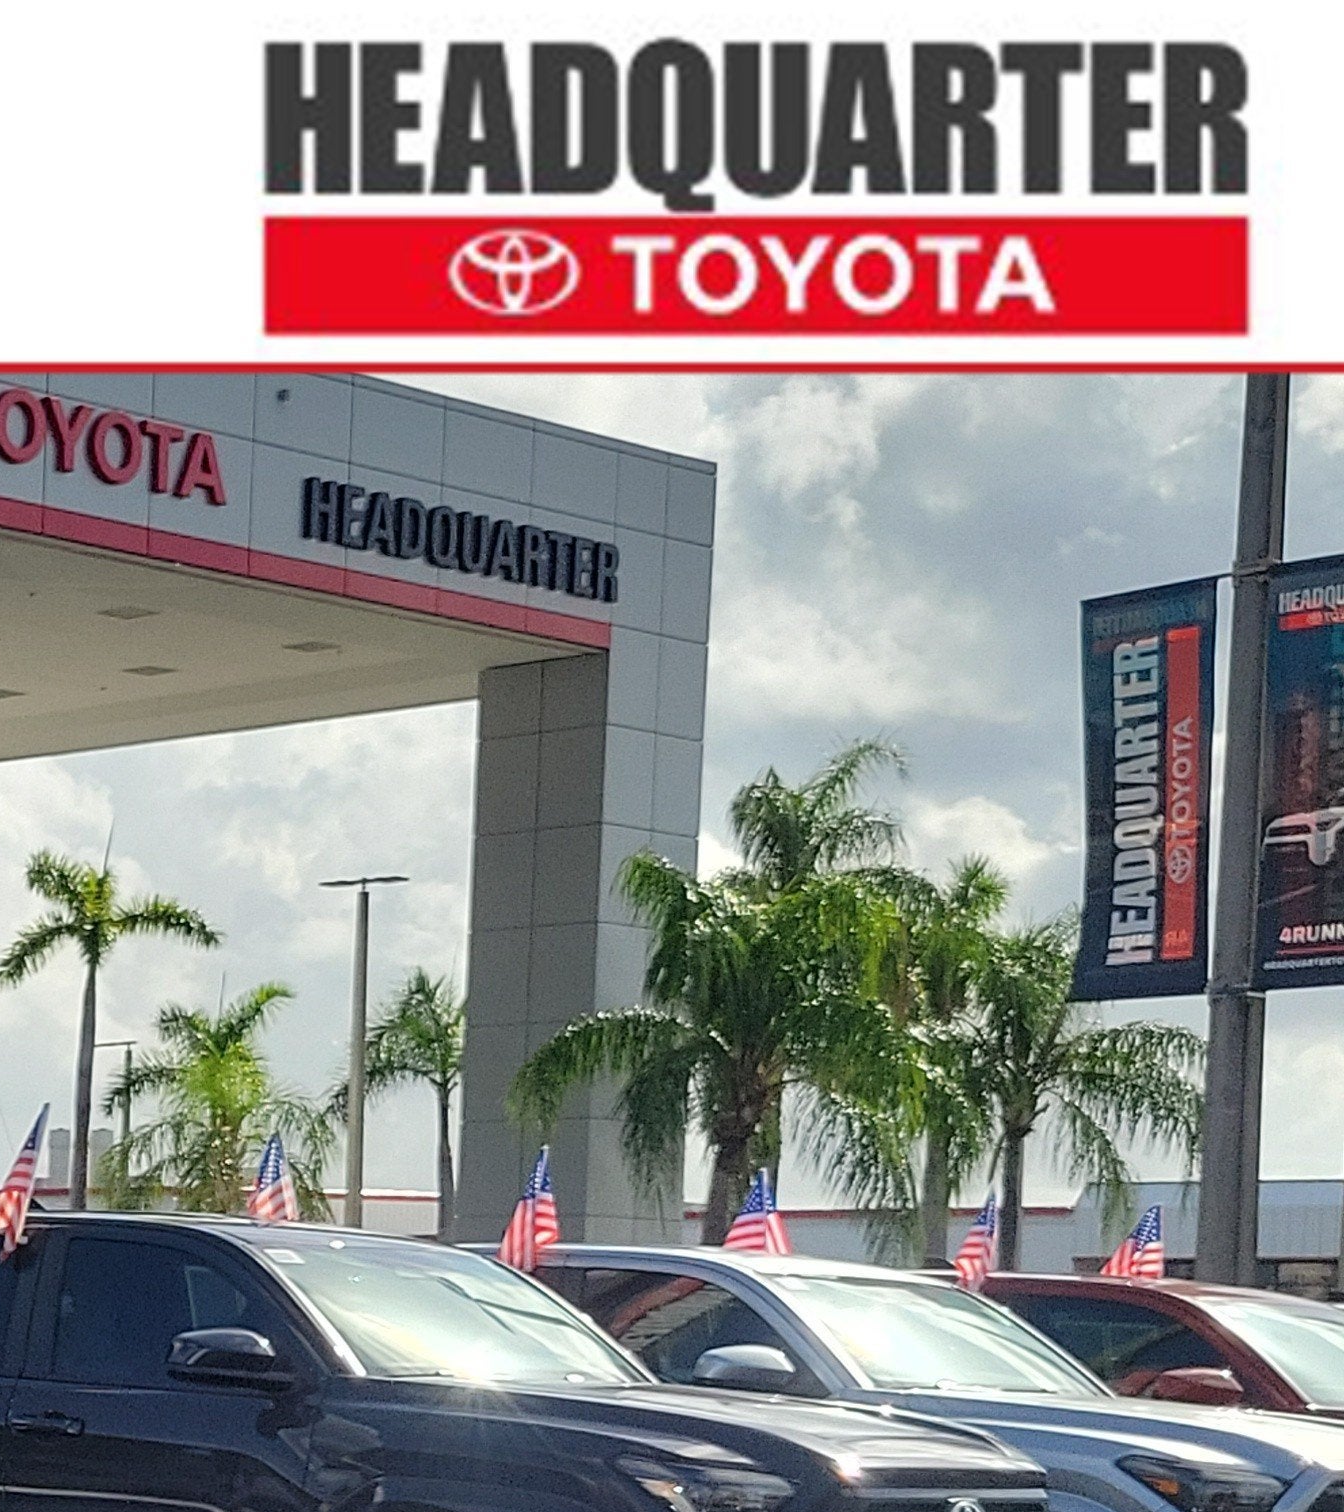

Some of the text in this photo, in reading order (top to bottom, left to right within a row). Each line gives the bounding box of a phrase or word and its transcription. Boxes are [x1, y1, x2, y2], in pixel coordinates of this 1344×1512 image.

[301, 477, 620, 602] HEADQUARTER
[1105, 635, 1164, 966] HEADQUARTER
[1172, 715, 1194, 841] TOYOTA
